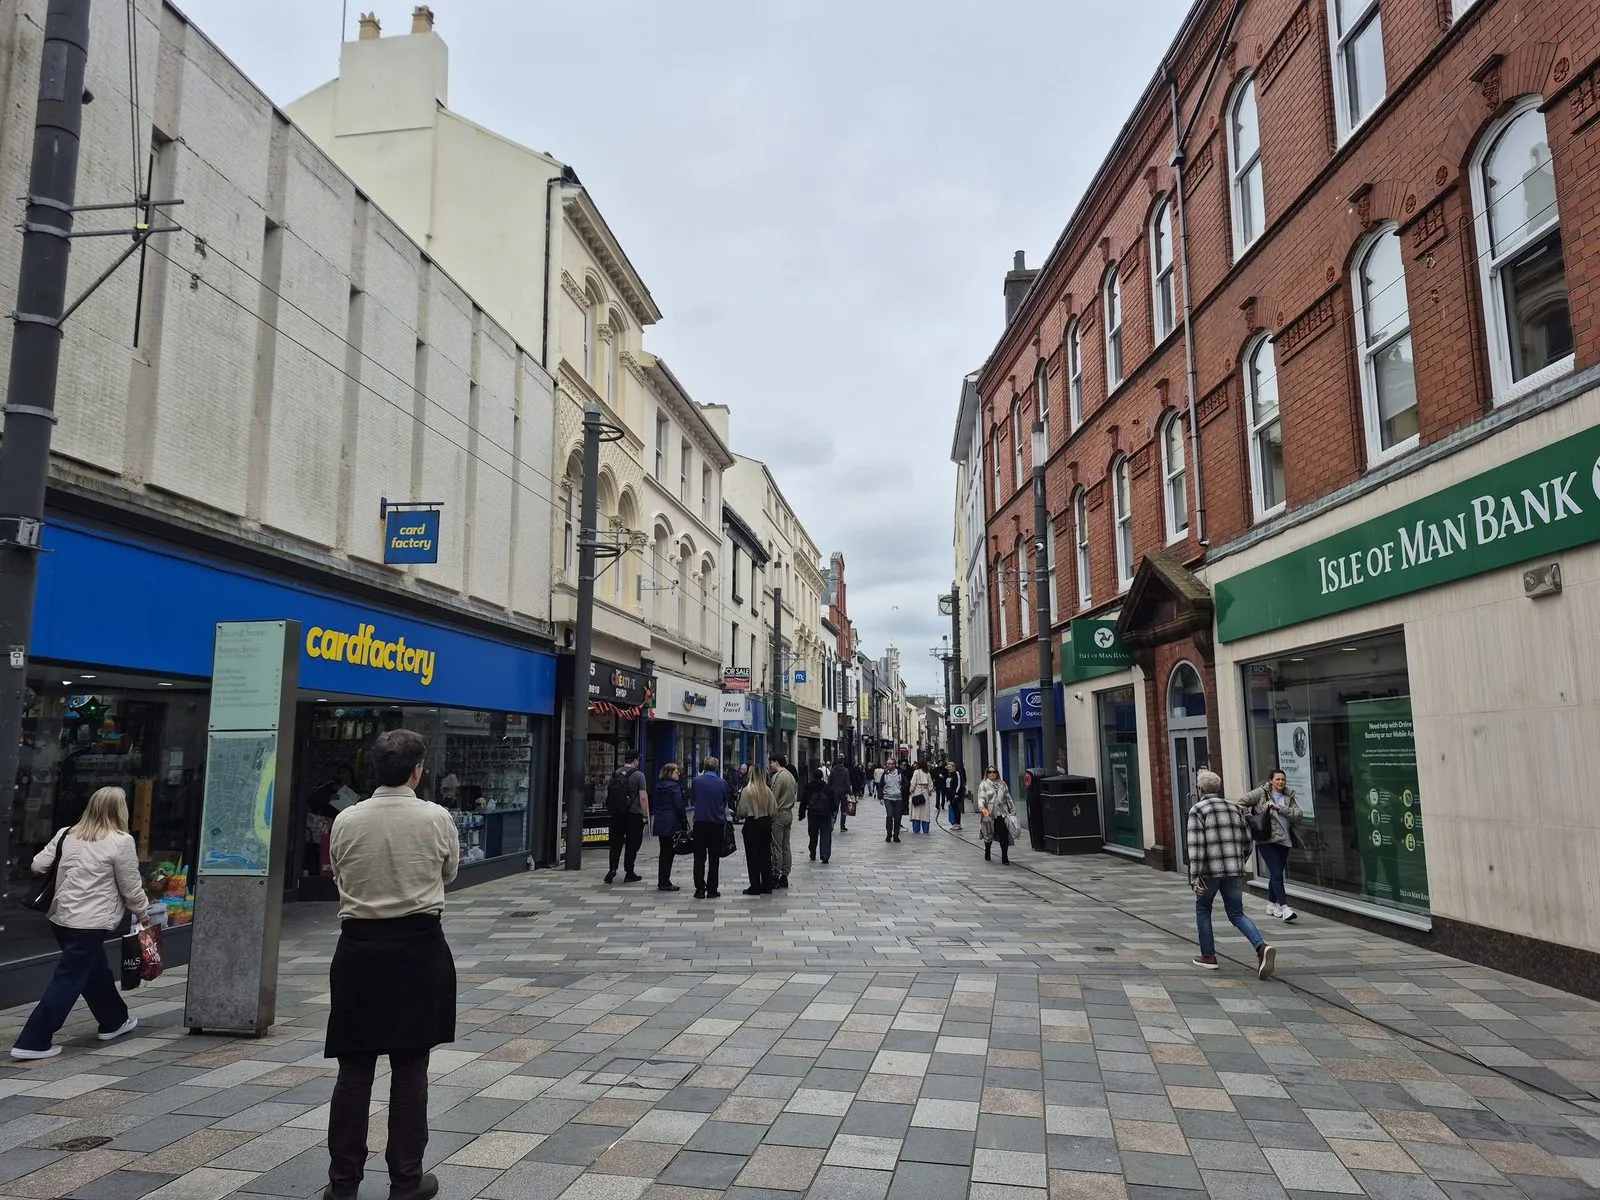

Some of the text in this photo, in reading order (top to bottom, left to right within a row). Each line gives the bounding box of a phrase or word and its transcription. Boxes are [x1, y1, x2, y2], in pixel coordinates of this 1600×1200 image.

[399, 523, 426, 535] card
[1318, 471, 1583, 595] ISLE OF MAN BANK
[391, 536, 432, 551] factory
[306, 622, 436, 686] cardfactory
[723, 667, 735, 675] OR
[615, 687, 627, 698] SHOP
[1398, 720, 1412, 728] Online
[1364, 731, 1381, 740] Banking
[1393, 730, 1407, 738] Mobile
[123, 956, 141, 967] M&S
